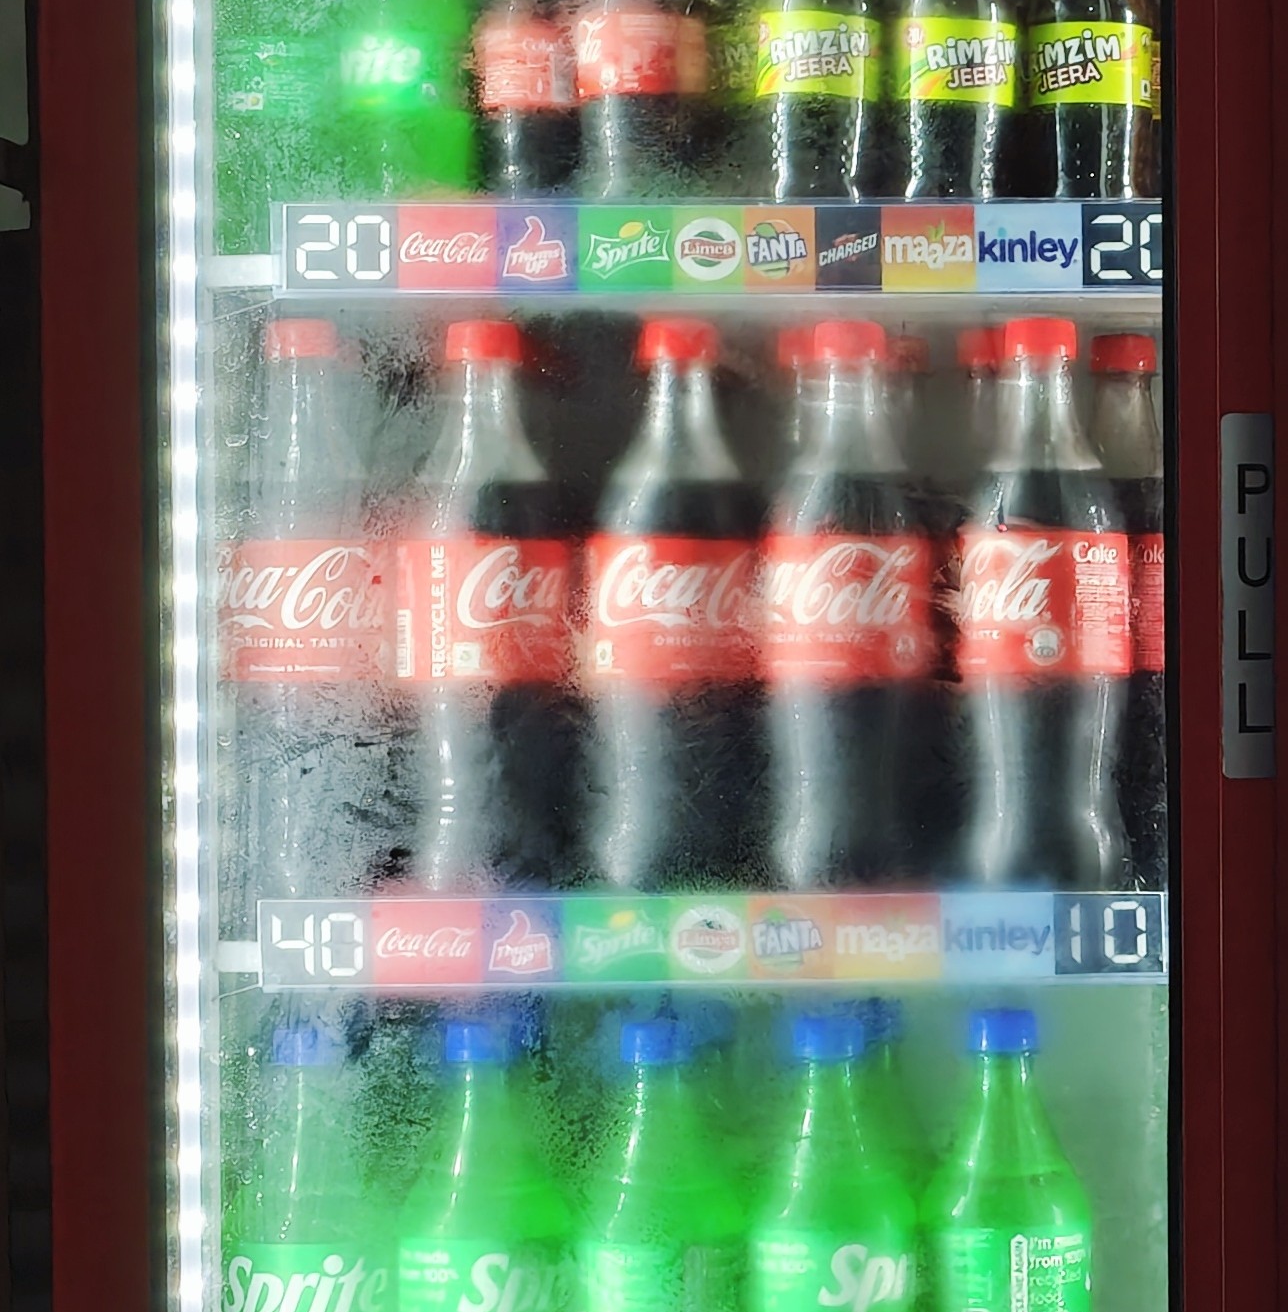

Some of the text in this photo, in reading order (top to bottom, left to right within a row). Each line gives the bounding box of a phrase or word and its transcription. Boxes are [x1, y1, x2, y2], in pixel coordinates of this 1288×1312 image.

[785, 56, 852, 81] JEERA
[948, 65, 1006, 88] JEERA
[1039, 61, 1101, 93] JEERA
[297, 214, 391, 280] 20
[400, 232, 494, 264] Coca-Cola
[597, 230, 661, 270] Sprite
[681, 240, 735, 256] Limca
[747, 233, 807, 260] FANTA
[818, 233, 877, 266] CHARGED
[884, 230, 973, 268] maaza
[979, 227, 1077, 267] kinley
[1073, 542, 1118, 563] Coke
[432, 545, 446, 677] RECYCLE ME
[1238, 463, 1273, 733] PULL
[271, 913, 363, 977] 40
[376, 926, 471, 959] Coca-Cola
[579, 925, 656, 964] Sprite
[753, 920, 822, 955] FANTA
[837, 922, 941, 962] maaza
[945, 920, 1050, 956] kinley
[1069, 902, 1146, 964] 10
